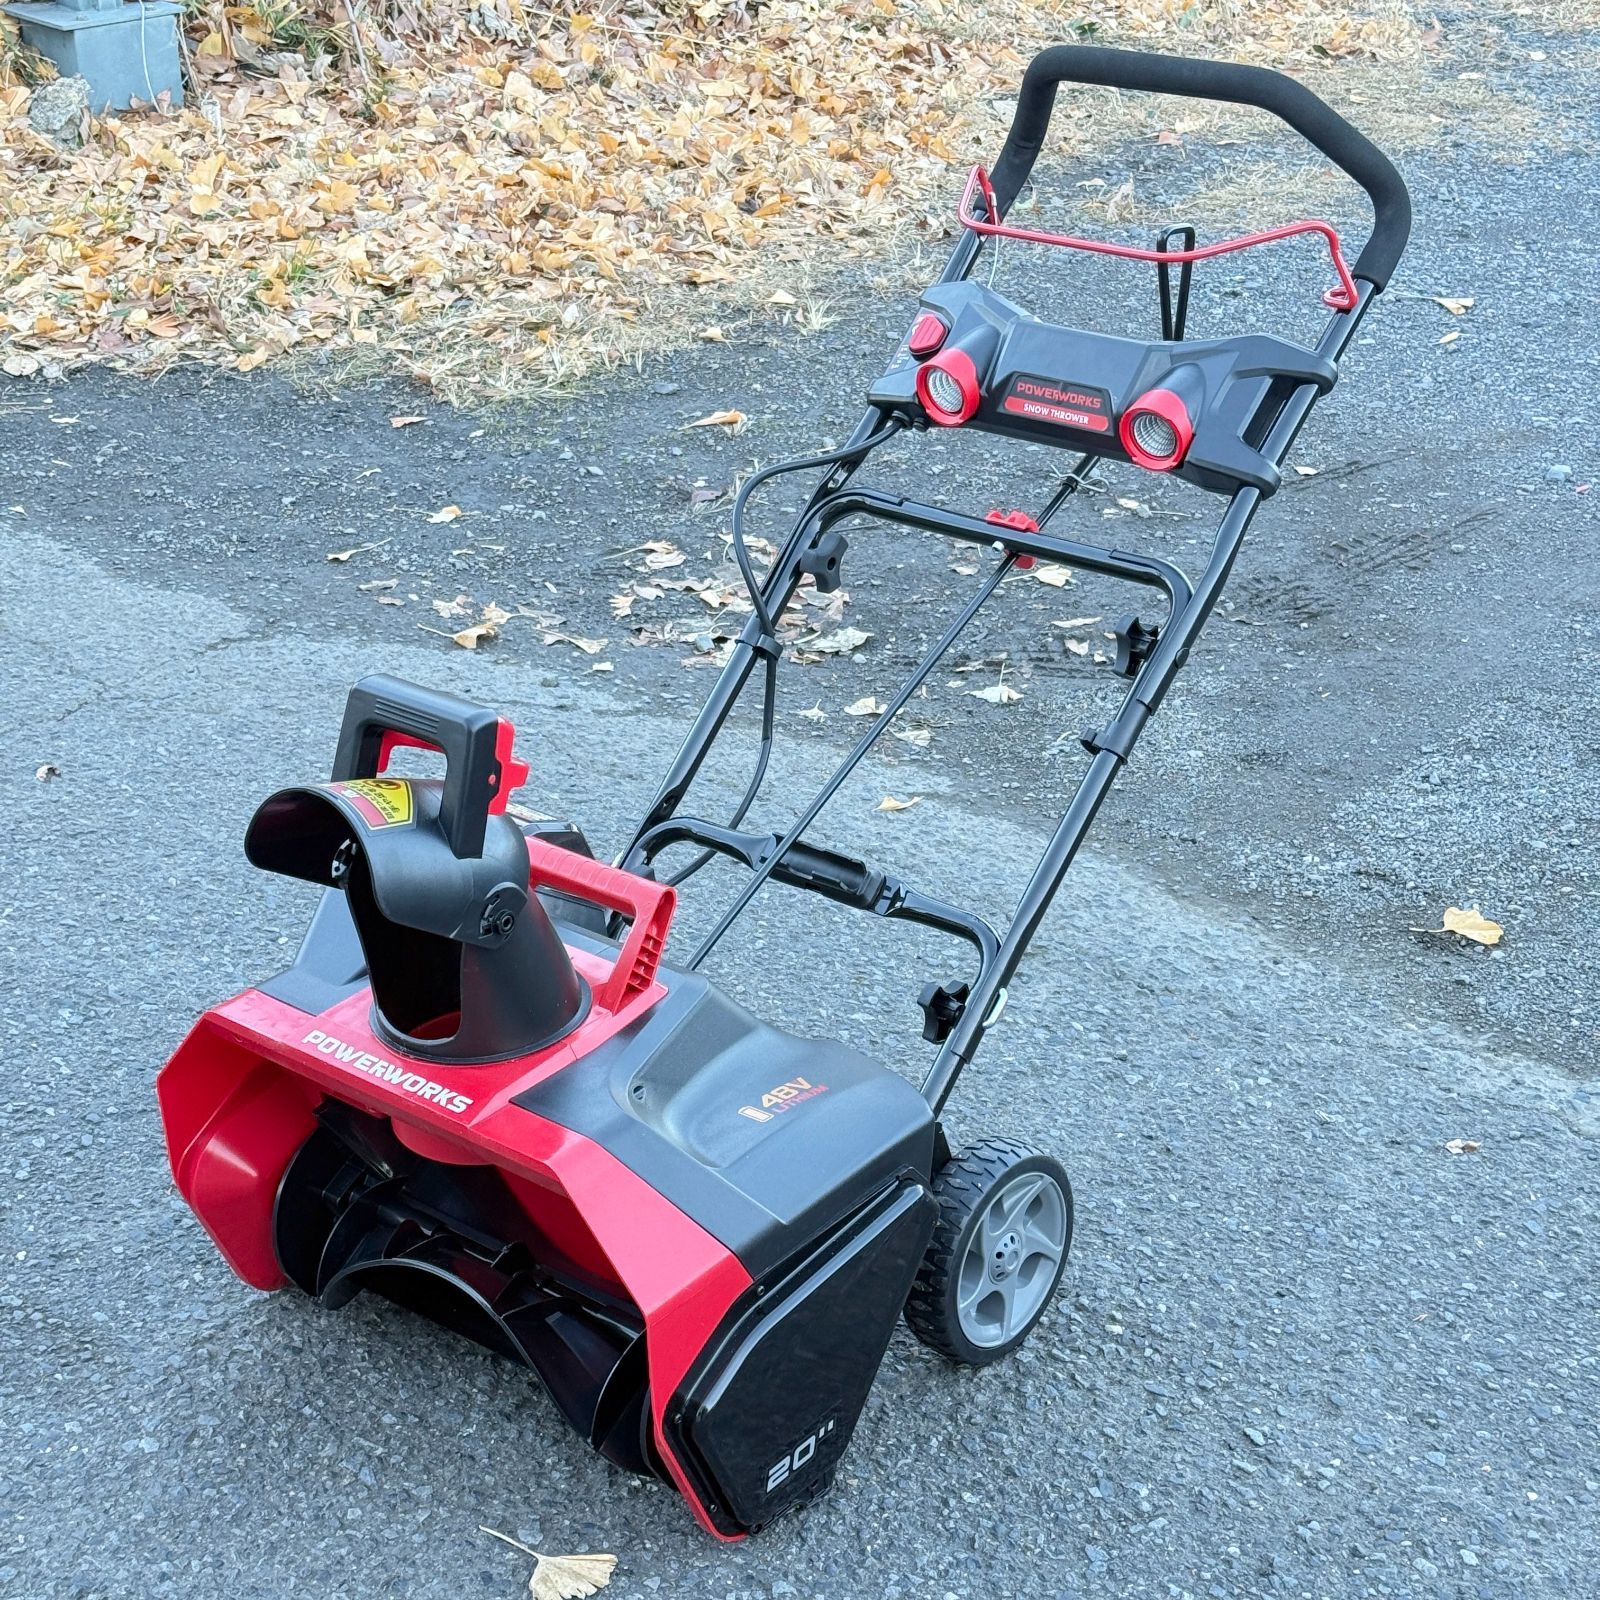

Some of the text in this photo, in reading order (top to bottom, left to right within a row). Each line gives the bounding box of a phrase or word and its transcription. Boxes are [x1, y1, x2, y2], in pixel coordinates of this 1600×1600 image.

[1017, 382, 1103, 409] POWERWORKS
[1023, 403, 1089, 425] SNOW THROWER
[301, 1030, 474, 1113] POWERWORKS
[761, 1076, 813, 1108] 48V
[766, 1419, 834, 1493] 20"
